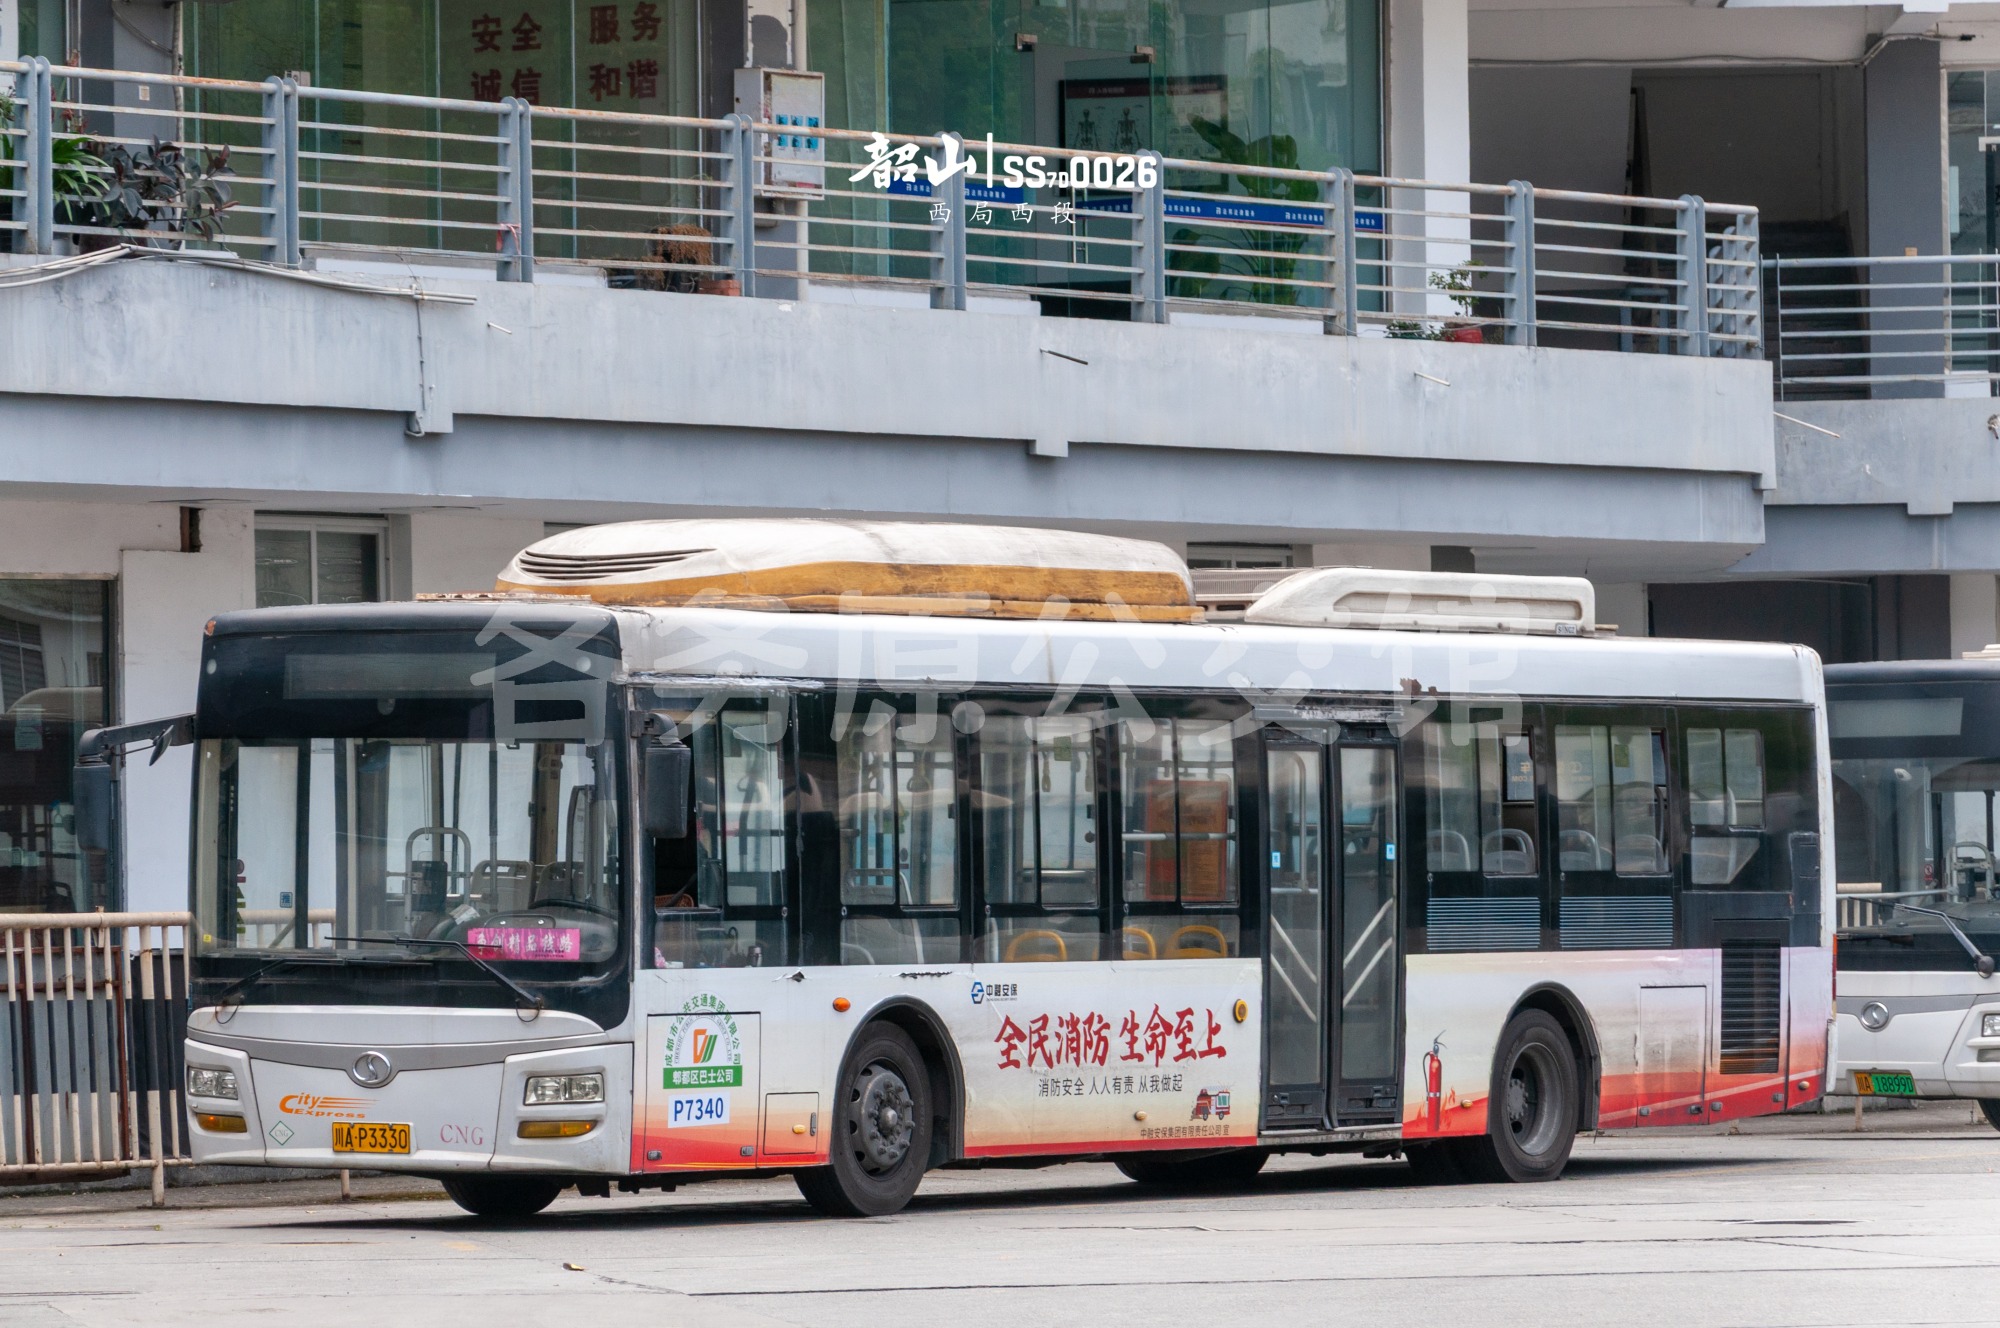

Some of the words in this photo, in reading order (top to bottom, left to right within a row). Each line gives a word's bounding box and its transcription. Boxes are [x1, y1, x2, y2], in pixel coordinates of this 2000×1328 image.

[472, 12, 542, 53] 安全
[589, 1, 661, 45] 服务
[471, 66, 542, 105] 诚信
[588, 59, 659, 102] 和谐
[986, 984, 1018, 997] 中融安保
[994, 1011, 1111, 1070] 全民消防
[1119, 1003, 1227, 1068] 生命至上
[673, 1069, 734, 1085] 郫都区巴士公司
[1038, 1076, 1085, 1098] 消防安全
[1088, 1075, 1134, 1096] 人人有责
[1138, 1073, 1183, 1094] 从我做起
[279, 1092, 323, 1114] City
[294, 1108, 365, 1118] Express
[674, 1097, 724, 1122] P7340
[440, 1123, 483, 1146] CNG
